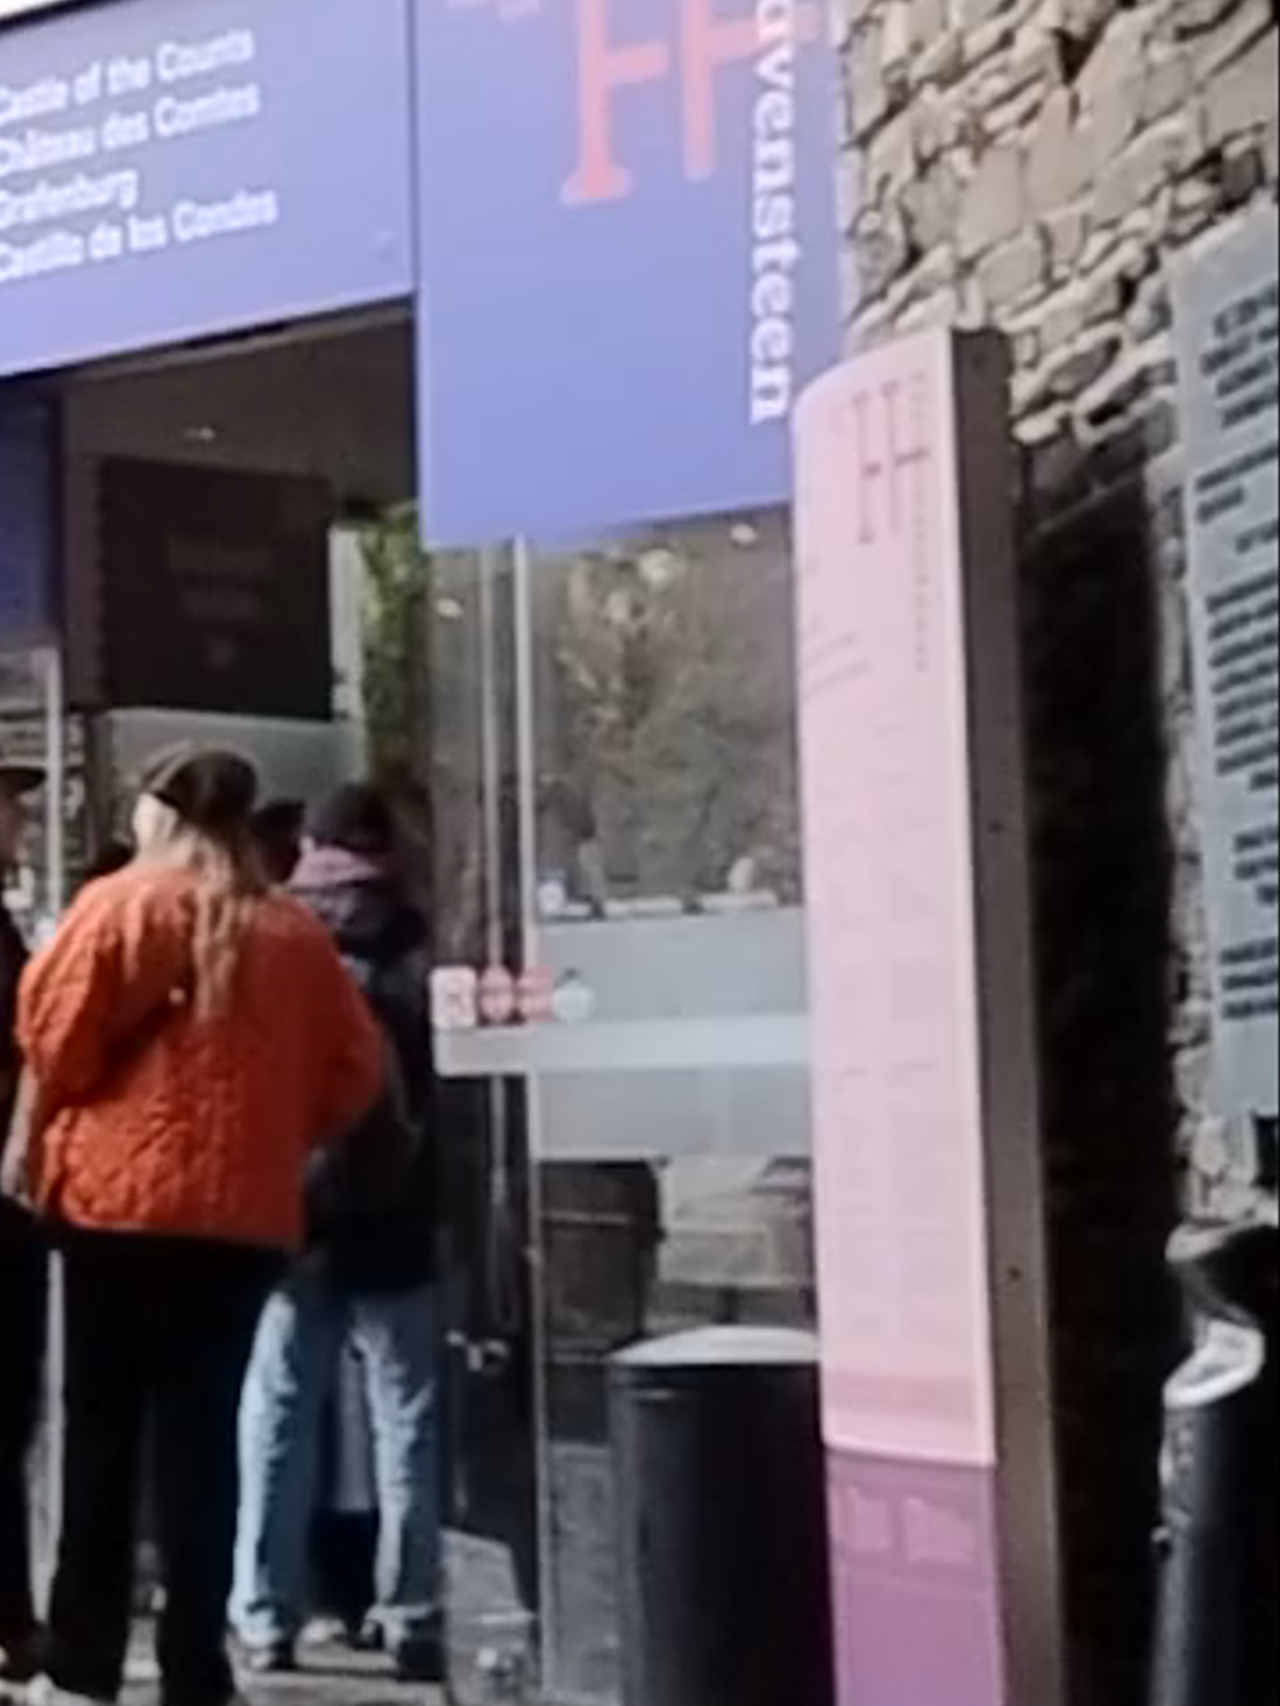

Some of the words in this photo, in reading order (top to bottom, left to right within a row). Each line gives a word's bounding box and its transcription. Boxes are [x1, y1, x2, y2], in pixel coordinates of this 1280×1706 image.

[74, 61, 100, 105] of
[107, 56, 150, 96] the
[157, 29, 254, 82] Counts
[102, 111, 148, 150] des
[155, 83, 259, 136] Comtes
[89, 221, 121, 260] de
[128, 215, 167, 251] los
[174, 188, 278, 241] Condes
